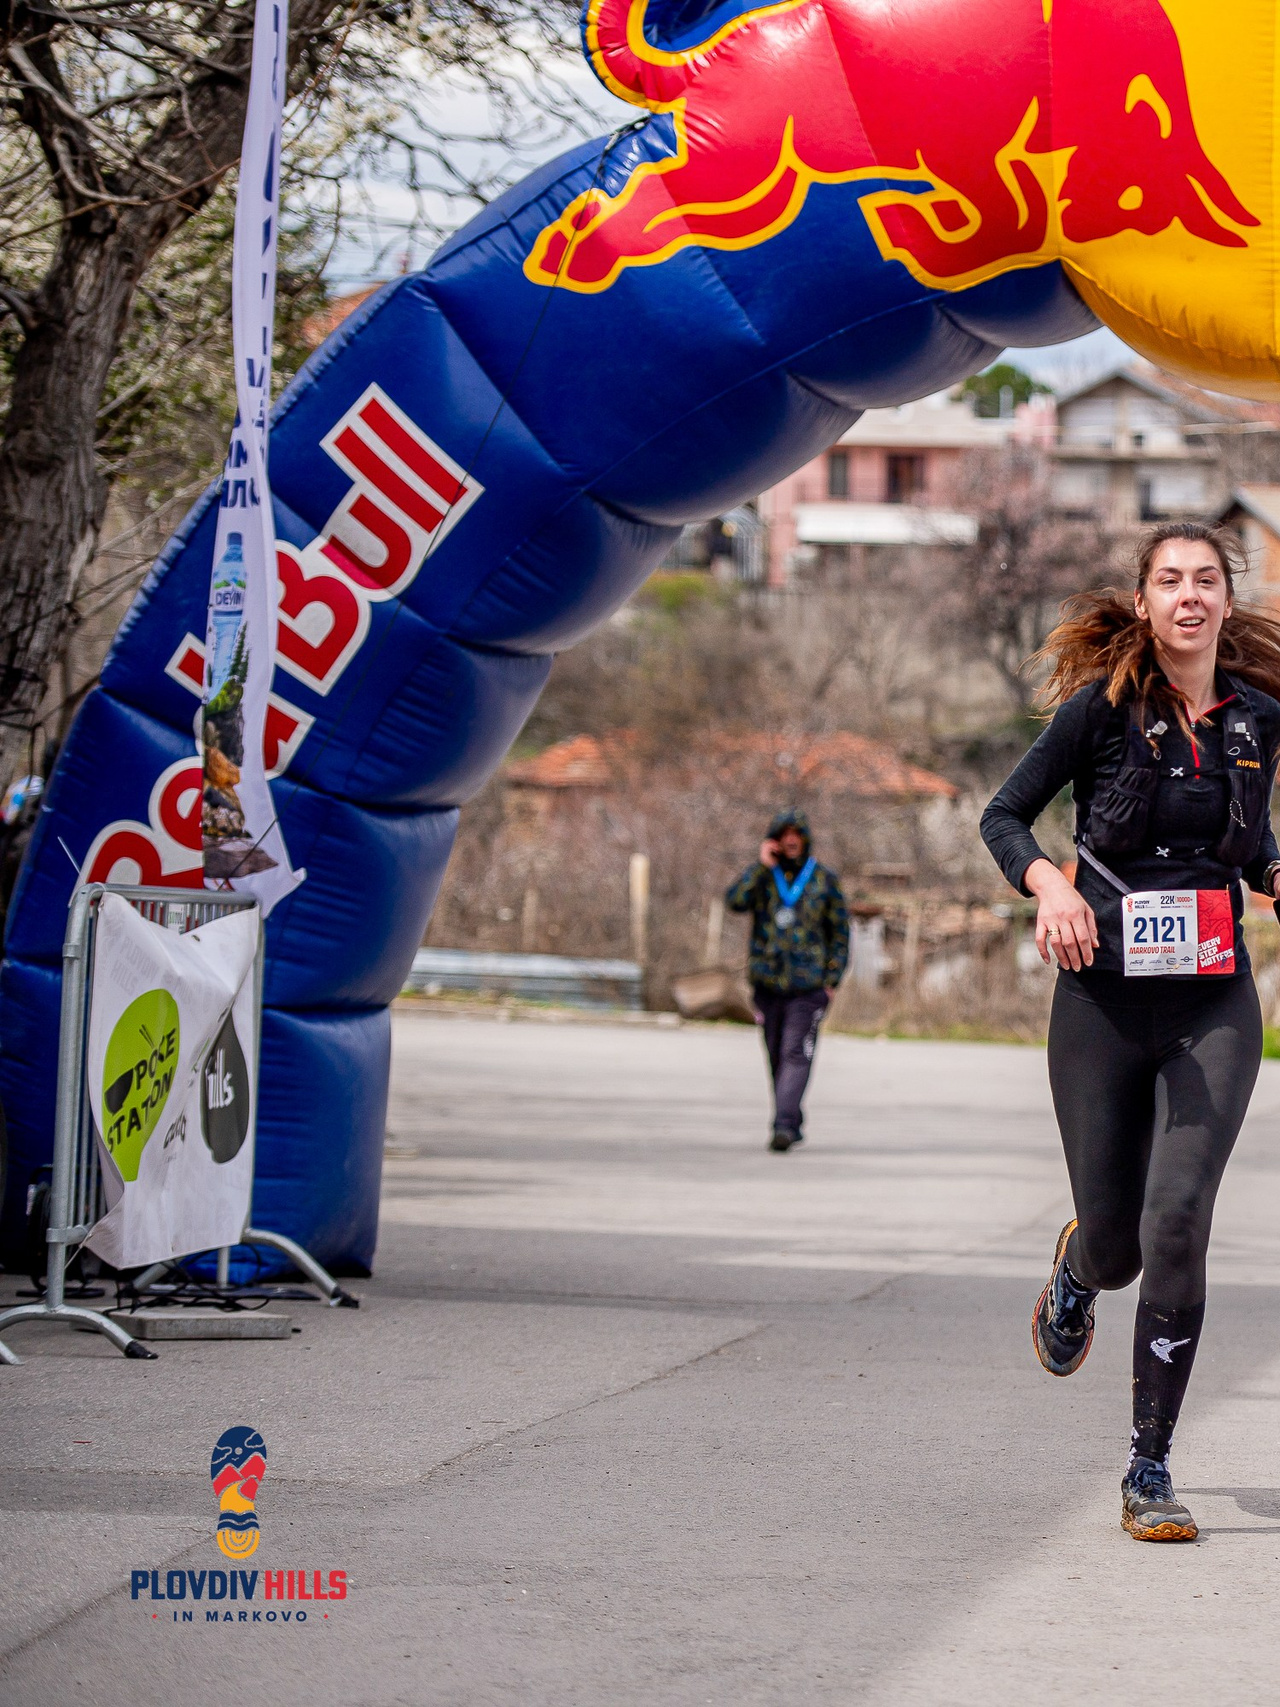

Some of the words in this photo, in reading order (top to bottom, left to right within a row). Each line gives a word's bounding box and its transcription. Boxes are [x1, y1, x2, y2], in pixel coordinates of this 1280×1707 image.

[270, 395, 476, 688] Bull
[1160, 895, 1175, 905] 22K
[1133, 915, 1186, 943] 2121
[1129, 946, 1159, 954] MARKOVO
[1160, 946, 1176, 954] TRAIL
